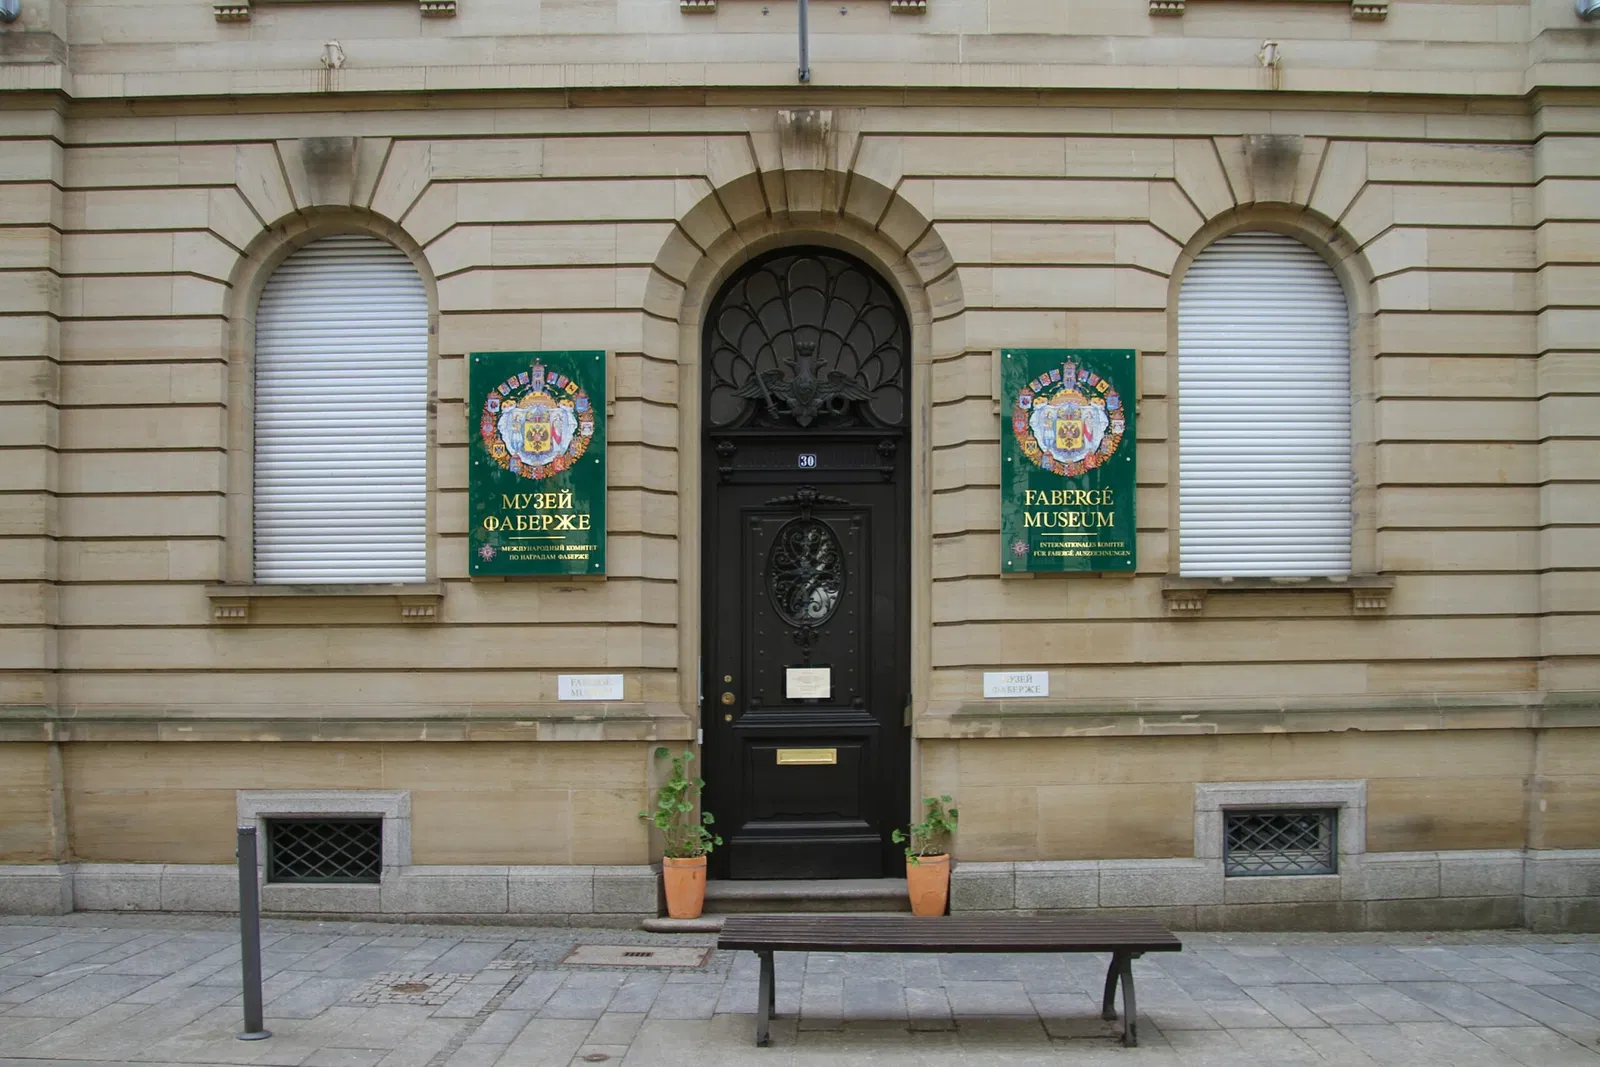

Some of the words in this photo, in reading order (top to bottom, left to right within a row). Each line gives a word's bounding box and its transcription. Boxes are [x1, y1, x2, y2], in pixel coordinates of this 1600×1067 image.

[801, 455, 814, 467] 30
[502, 488, 573, 510] МУЗЕЙ
[1024, 486, 1114, 506] FABERGÉ
[483, 514, 591, 532] ФАБЕРЖЕ
[1023, 511, 1115, 528] MUSEUM
